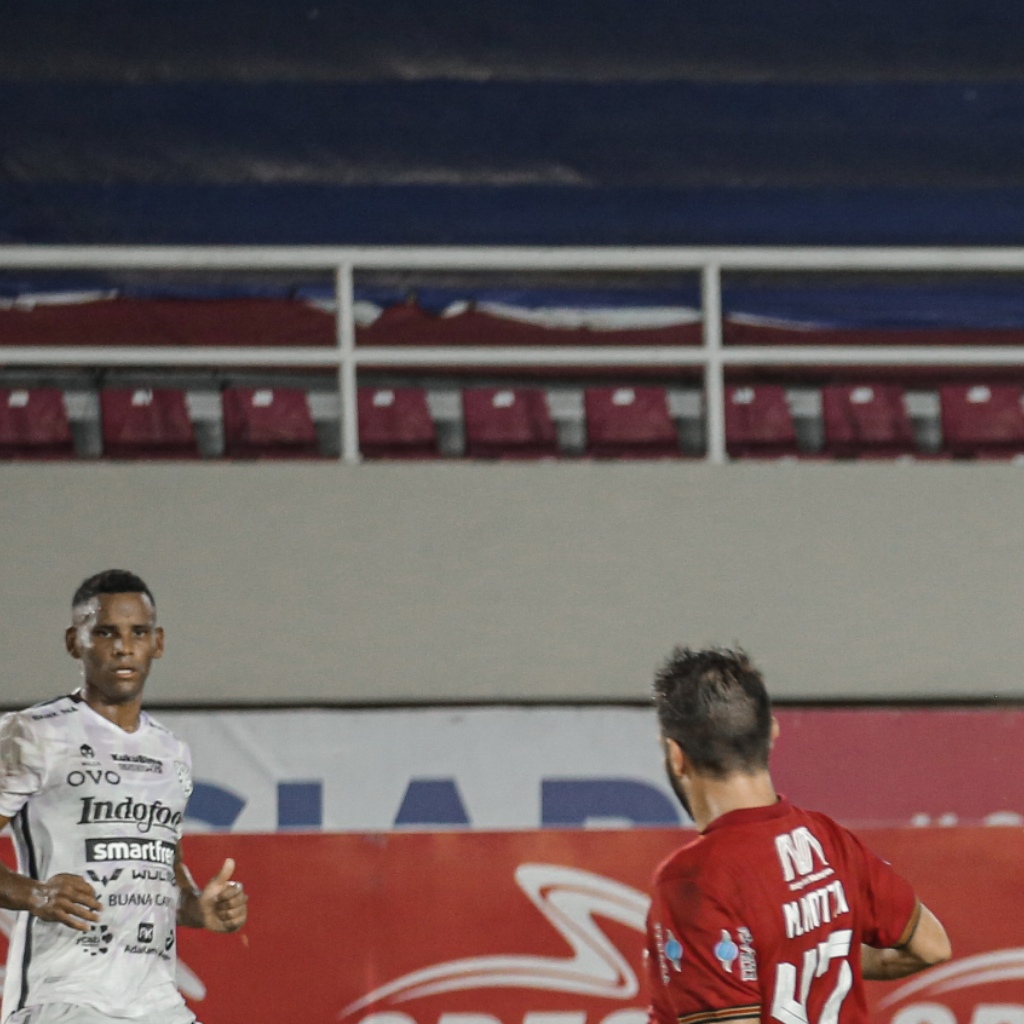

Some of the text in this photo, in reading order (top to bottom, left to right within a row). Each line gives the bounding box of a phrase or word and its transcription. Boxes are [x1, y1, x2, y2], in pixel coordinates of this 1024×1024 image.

[66, 770, 121, 787] OVO
[77, 796, 182, 833] Indofoo
[93, 840, 174, 866] smartfre
[108, 894, 152, 907] BUANA
